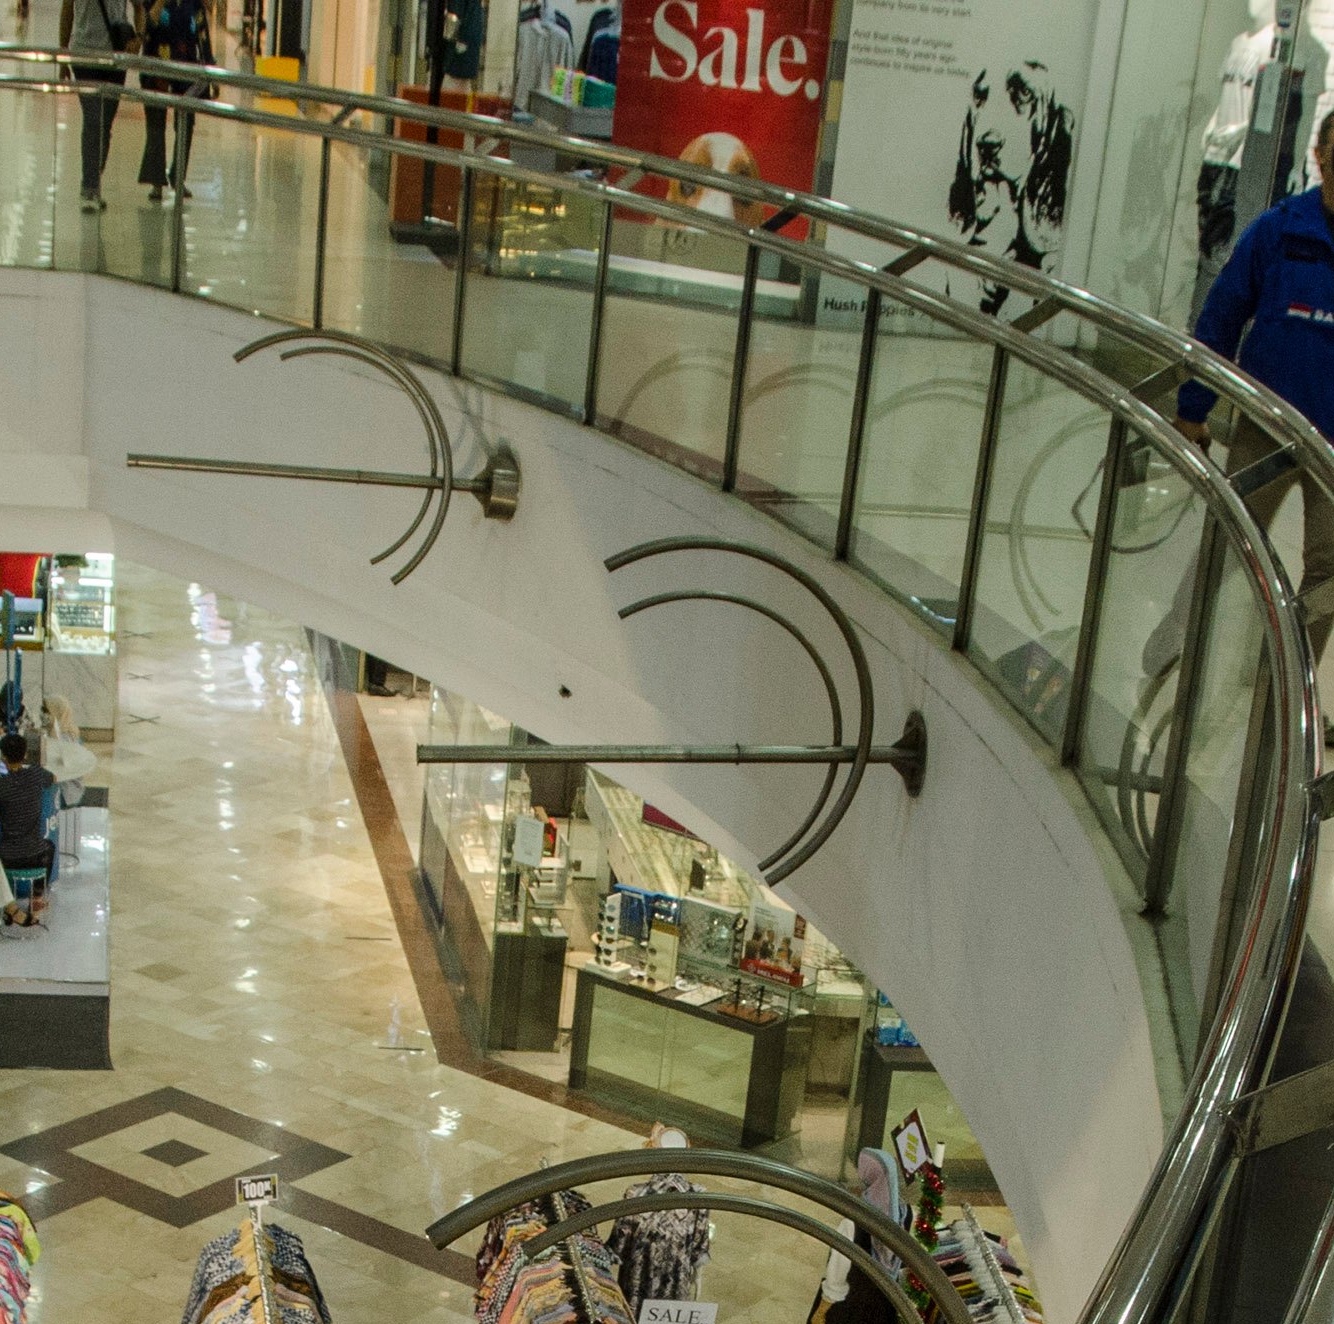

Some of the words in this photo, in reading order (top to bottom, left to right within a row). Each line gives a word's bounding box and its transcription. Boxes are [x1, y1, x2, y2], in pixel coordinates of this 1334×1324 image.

[649, 0, 820, 100] Sale.
[824, 296, 858, 311] Hush
[243, 1181, 271, 1199] 100K
